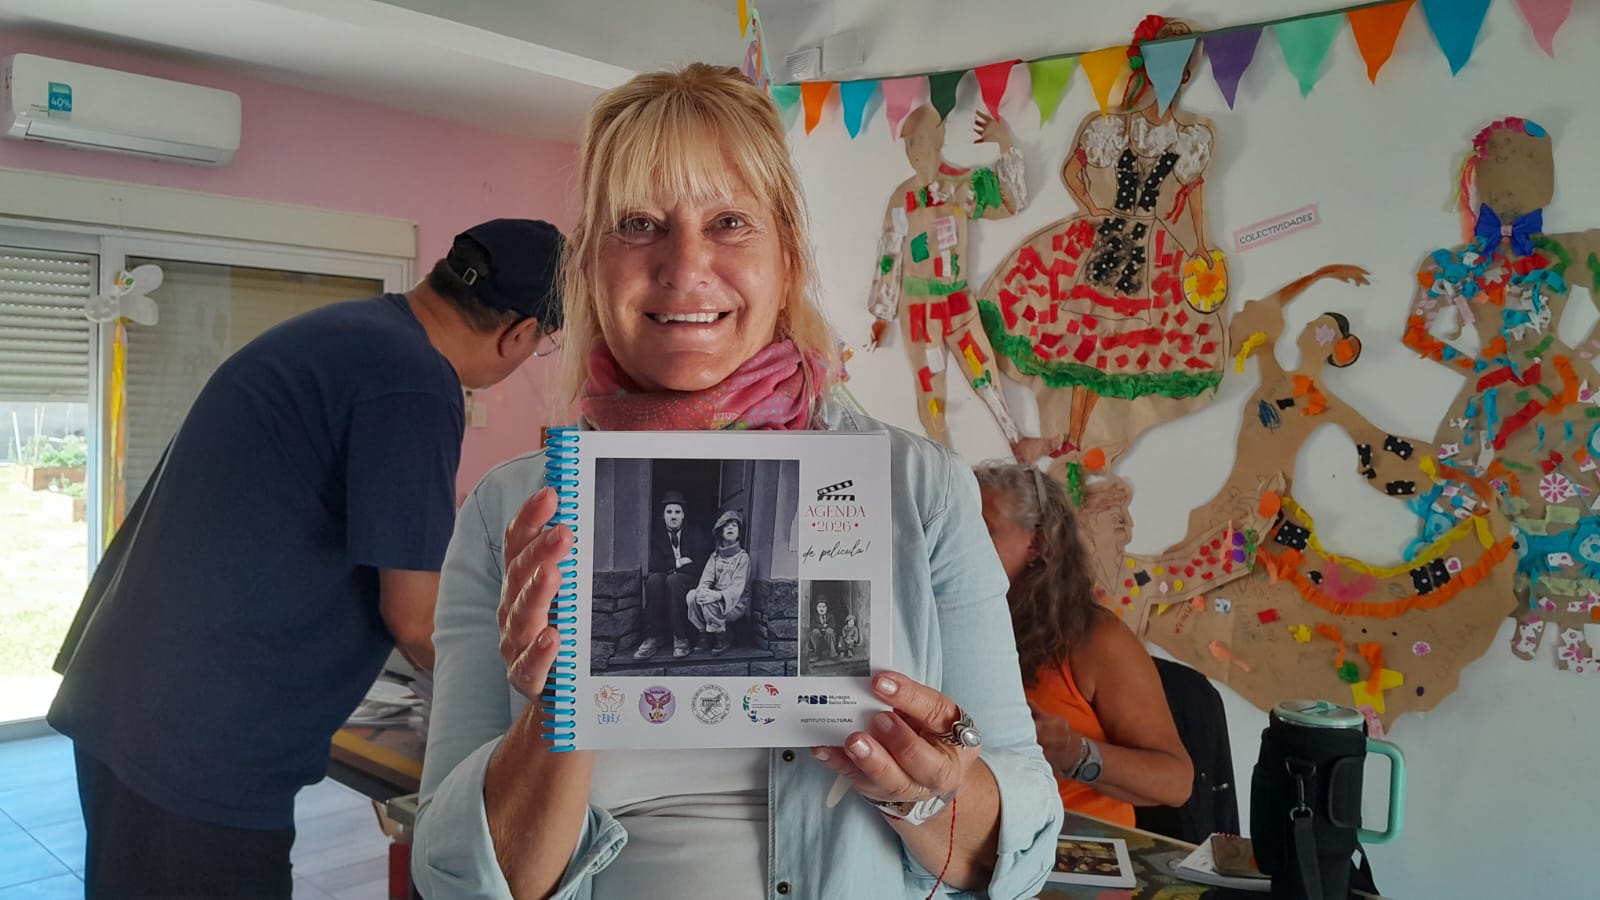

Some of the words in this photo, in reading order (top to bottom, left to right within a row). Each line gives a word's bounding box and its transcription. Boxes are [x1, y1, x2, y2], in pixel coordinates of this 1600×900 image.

[51, 97, 72, 108] 40%
[1239, 212, 1313, 245] COLECTIVIDADES
[805, 505, 866, 518] AGENDA
[816, 521, 852, 532] 2026
[802, 544, 816, 564] de
